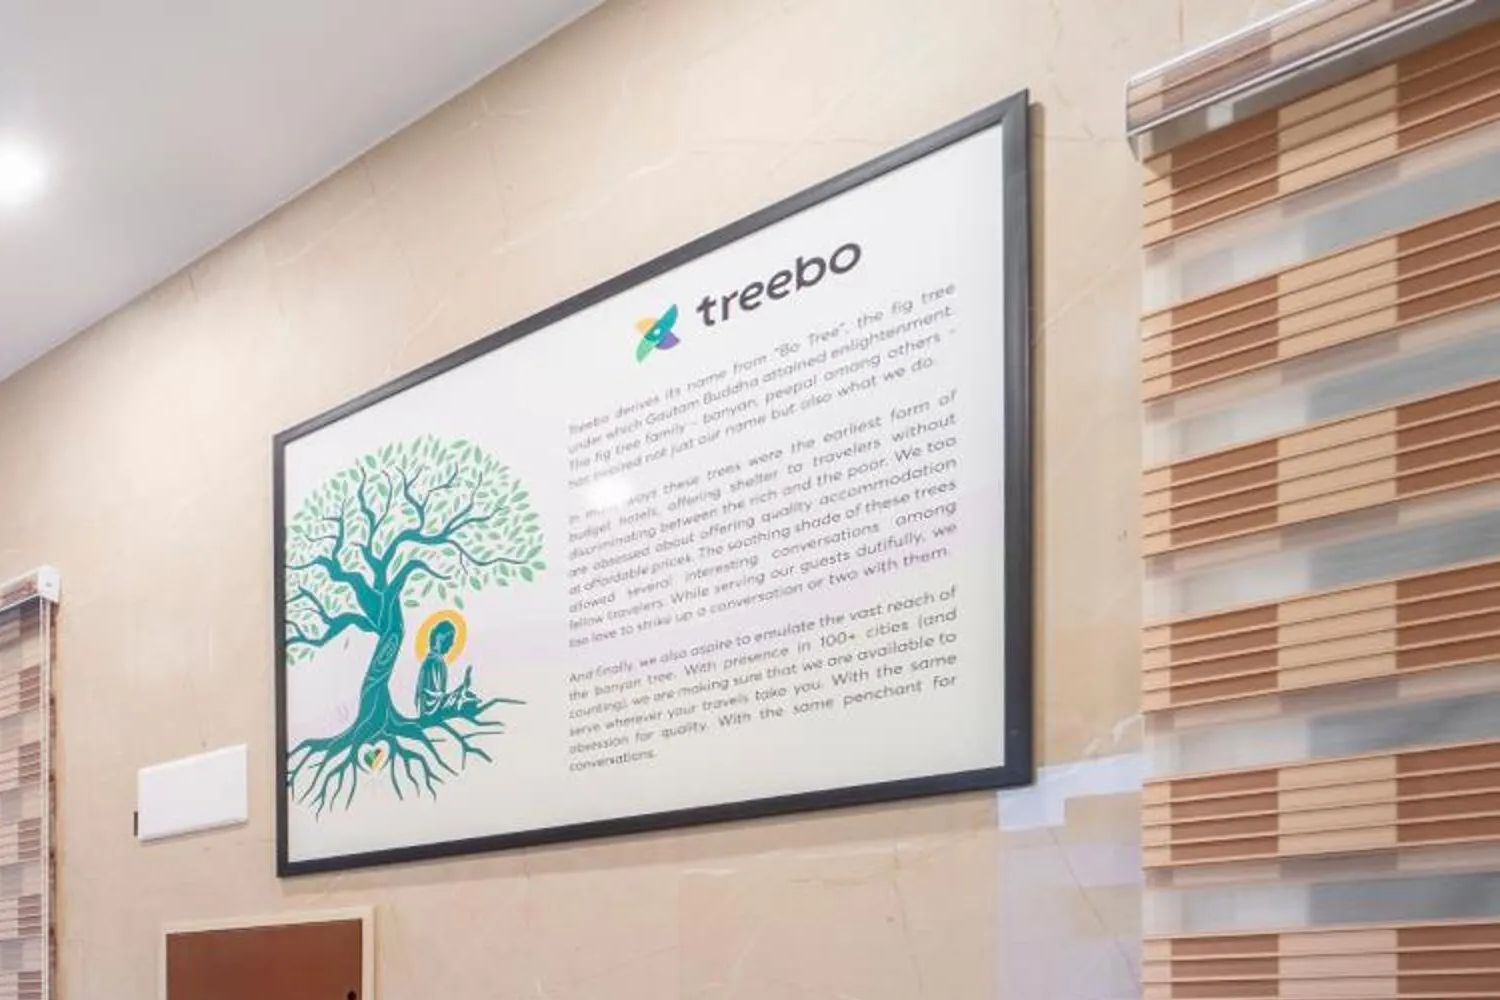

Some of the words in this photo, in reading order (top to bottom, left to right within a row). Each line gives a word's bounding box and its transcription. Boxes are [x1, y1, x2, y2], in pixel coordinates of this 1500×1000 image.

[696, 242, 862, 327] treebo
[688, 369, 726, 390] name
[733, 355, 765, 374] from
[857, 310, 883, 328] the
[892, 299, 913, 315] fig
[921, 284, 955, 304] tree
[703, 377, 758, 404] Buddha
[762, 349, 826, 382] attained
[595, 449, 610, 461] fig
[616, 438, 640, 454] tree
[645, 422, 684, 444] family
[765, 373, 816, 404] peepal
[823, 353, 880, 381] among
[887, 332, 940, 358] others
[697, 429, 720, 444] our
[725, 414, 765, 435] name
[771, 400, 797, 419] but
[801, 391, 831, 409] also
[837, 373, 876, 396] what
[883, 366, 905, 381] we
[707, 461, 740, 479] trees
[748, 447, 782, 466] were
[790, 437, 815, 453] the
[822, 412, 881, 442] earliest
[890, 401, 929, 421] form
[938, 389, 956, 406] of
[659, 507, 716, 532] between
[722, 499, 744, 513] the
[749, 487, 776, 505] rich
[783, 476, 811, 495] and
[817, 470, 841, 486] the
[893, 447, 921, 462] We
[927, 436, 956, 453] too
[667, 487, 721, 510] offering
[729, 469, 777, 491] shelter
[787, 461, 802, 474] to
[813, 437, 880, 466] travelers
[891, 411, 955, 441] without
[655, 530, 694, 552] about
[700, 516, 754, 539] offering
[761, 499, 811, 524] quality
[819, 458, 956, 505] accommodation
[684, 554, 758, 582] interesting
[771, 522, 879, 559] conversations
[894, 501, 956, 526] among
[699, 544, 723, 558] The
[728, 525, 790, 550] soothing
[795, 511, 840, 532] shade
[845, 503, 860, 518] of
[866, 492, 910, 513] these
[915, 479, 956, 500] trees
[620, 624, 633, 635] to
[675, 610, 692, 622] up
[697, 606, 706, 616] a
[709, 583, 802, 613] conversation
[807, 577, 822, 589] or
[829, 569, 857, 584] two
[863, 556, 897, 575] with
[671, 585, 709, 603] While
[713, 572, 764, 593] serving
[770, 564, 795, 578] our
[800, 549, 850, 574] guests
[932, 523, 956, 537] we
[659, 649, 686, 662] also
[690, 638, 732, 655] aspire
[736, 633, 751, 645] to
[754, 619, 815, 641] emulate
[819, 612, 844, 627] the
[849, 601, 882, 620] vast
[887, 590, 934, 612] reach
[939, 584, 956, 600] of
[684, 659, 716, 676] With
[723, 646, 788, 671] presence
[797, 640, 810, 652] in
[820, 631, 855, 647] 100+
[865, 620, 908, 638] cities
[918, 607, 956, 630] (and
[632, 694, 649, 705] we
[653, 689, 673, 701] are
[677, 678, 728, 696] making
[733, 671, 762, 685] sure
[767, 661, 798, 678] that
[802, 658, 822, 671] we
[827, 652, 852, 666] are
[857, 635, 934, 660] available
[939, 630, 956, 644] to
[667, 704, 694, 720] your
[702, 692, 748, 710] travels
[755, 685, 787, 700] take
[831, 667, 868, 685] With
[876, 662, 903, 677] the
[910, 653, 956, 671] same
[634, 730, 653, 741] for
[718, 709, 751, 726] With
[759, 705, 783, 719] the
[793, 697, 833, 712] same
[843, 677, 922, 707] penchant
